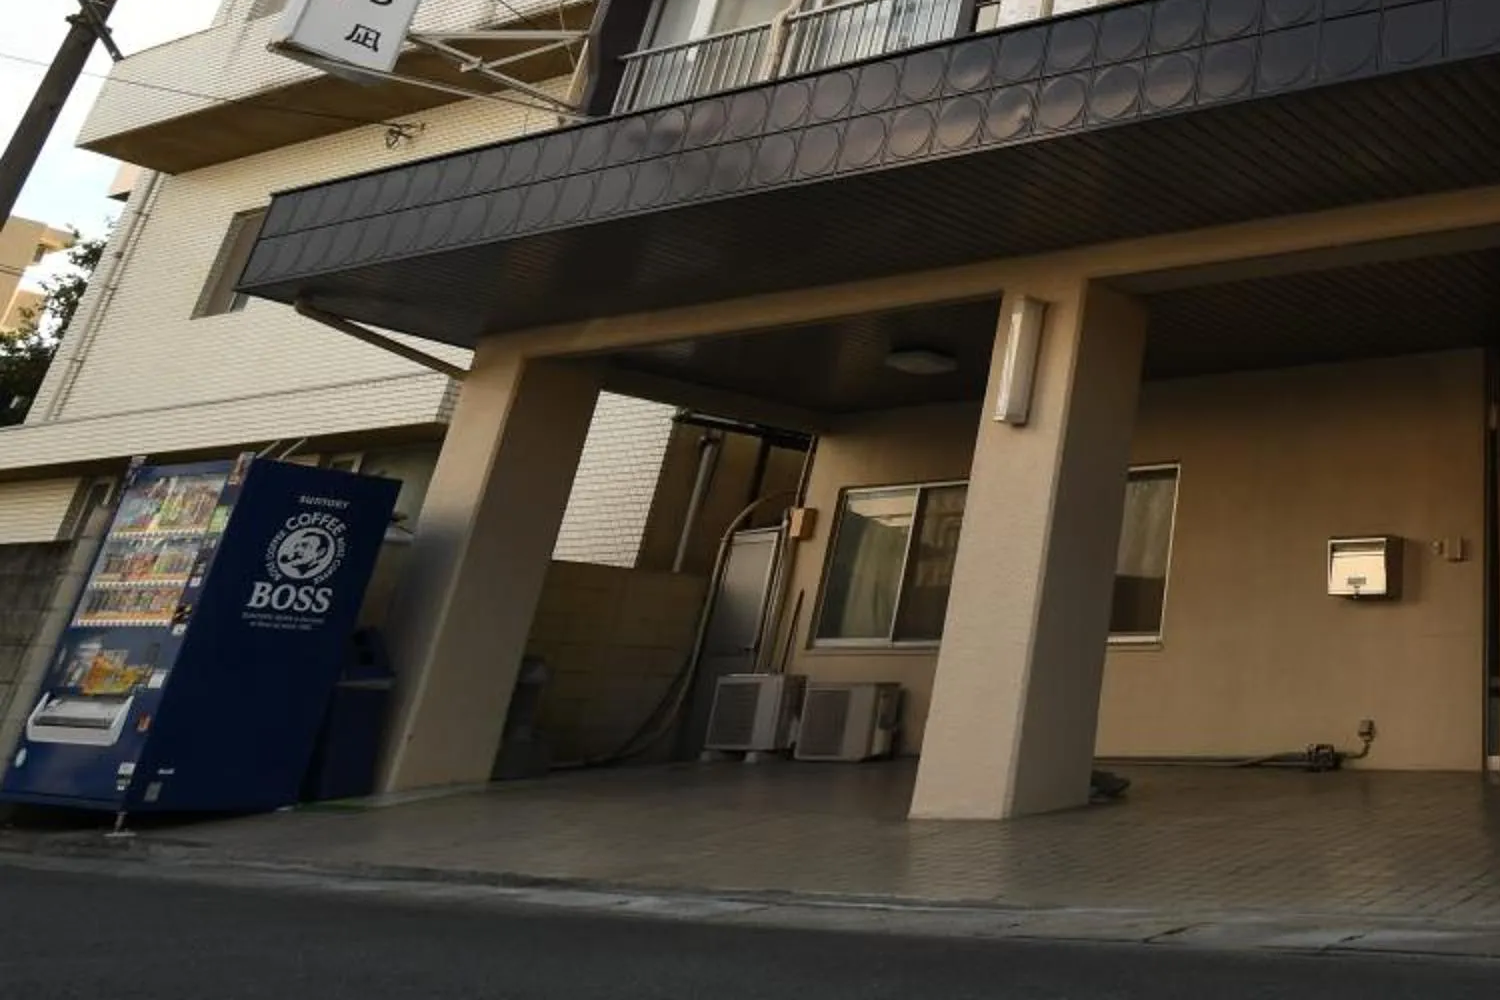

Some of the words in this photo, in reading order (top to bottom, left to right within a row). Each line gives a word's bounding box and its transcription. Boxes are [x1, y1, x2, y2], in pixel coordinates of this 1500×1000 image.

[344, 23, 382, 53] 凪
[285, 511, 347, 536] COFFEE
[245, 581, 333, 613] BOSS
